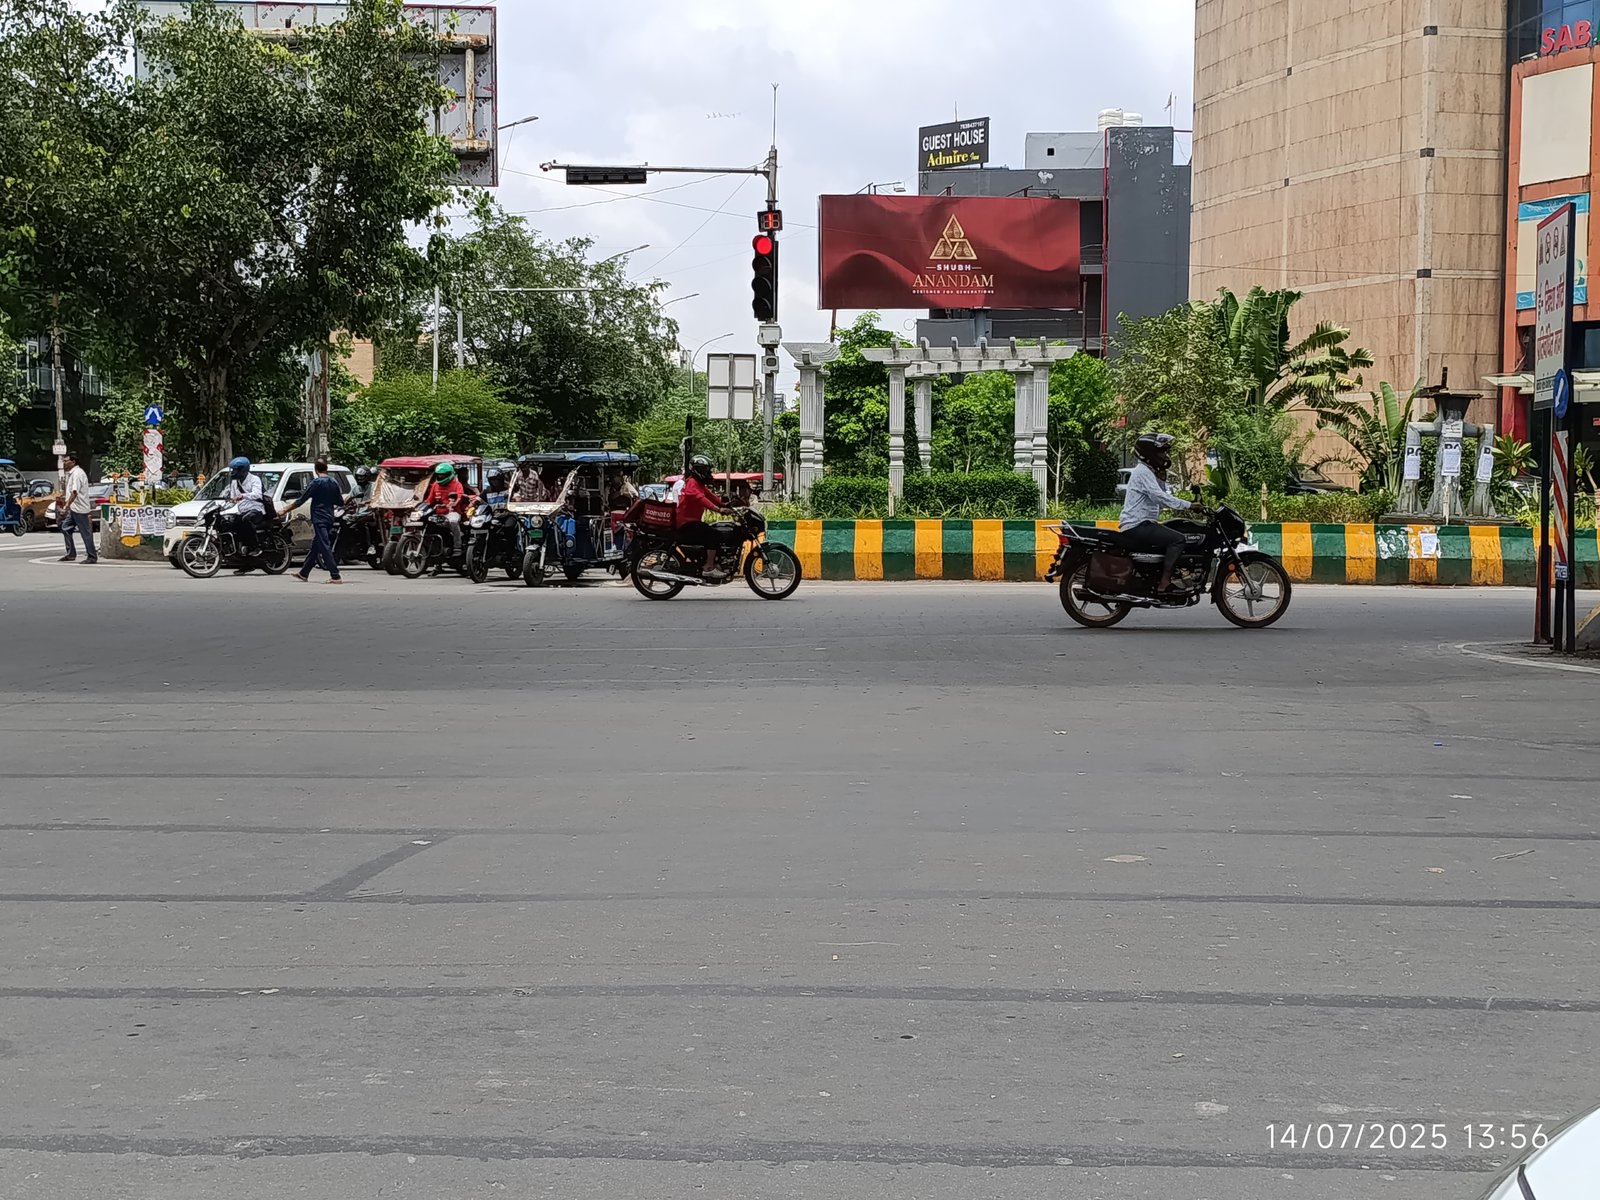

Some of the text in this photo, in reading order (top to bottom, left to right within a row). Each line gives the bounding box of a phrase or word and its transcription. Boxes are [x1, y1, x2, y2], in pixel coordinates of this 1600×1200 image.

[1540, 20, 1592, 55] SAB
[922, 128, 985, 151] GUEST HOUSE
[927, 150, 968, 167] Admire
[912, 274, 994, 287] ANANDAM
[645, 509, 671, 518] zomato
